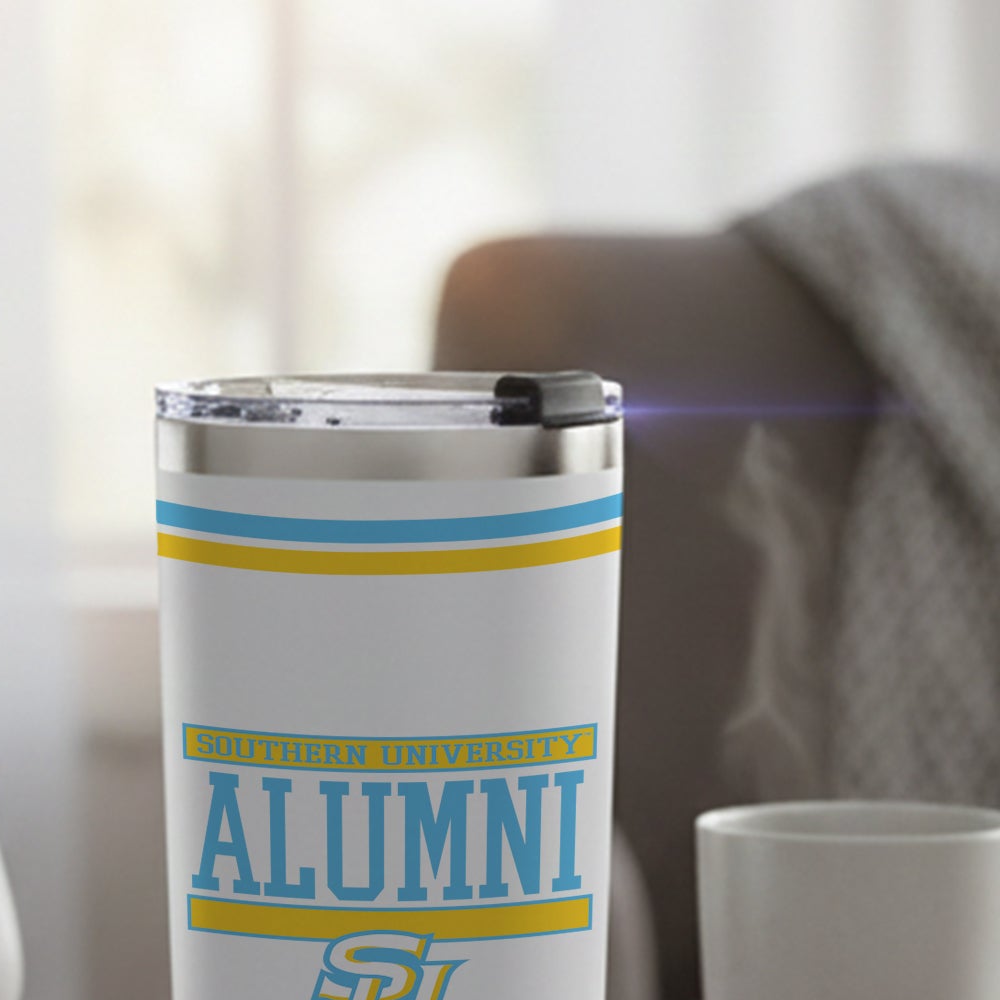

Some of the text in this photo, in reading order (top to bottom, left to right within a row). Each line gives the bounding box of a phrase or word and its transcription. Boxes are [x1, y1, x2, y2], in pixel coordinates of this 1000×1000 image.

[196, 733, 583, 766] SOUTHERN UNIVERSITY
[192, 770, 584, 901] ALUMNI
